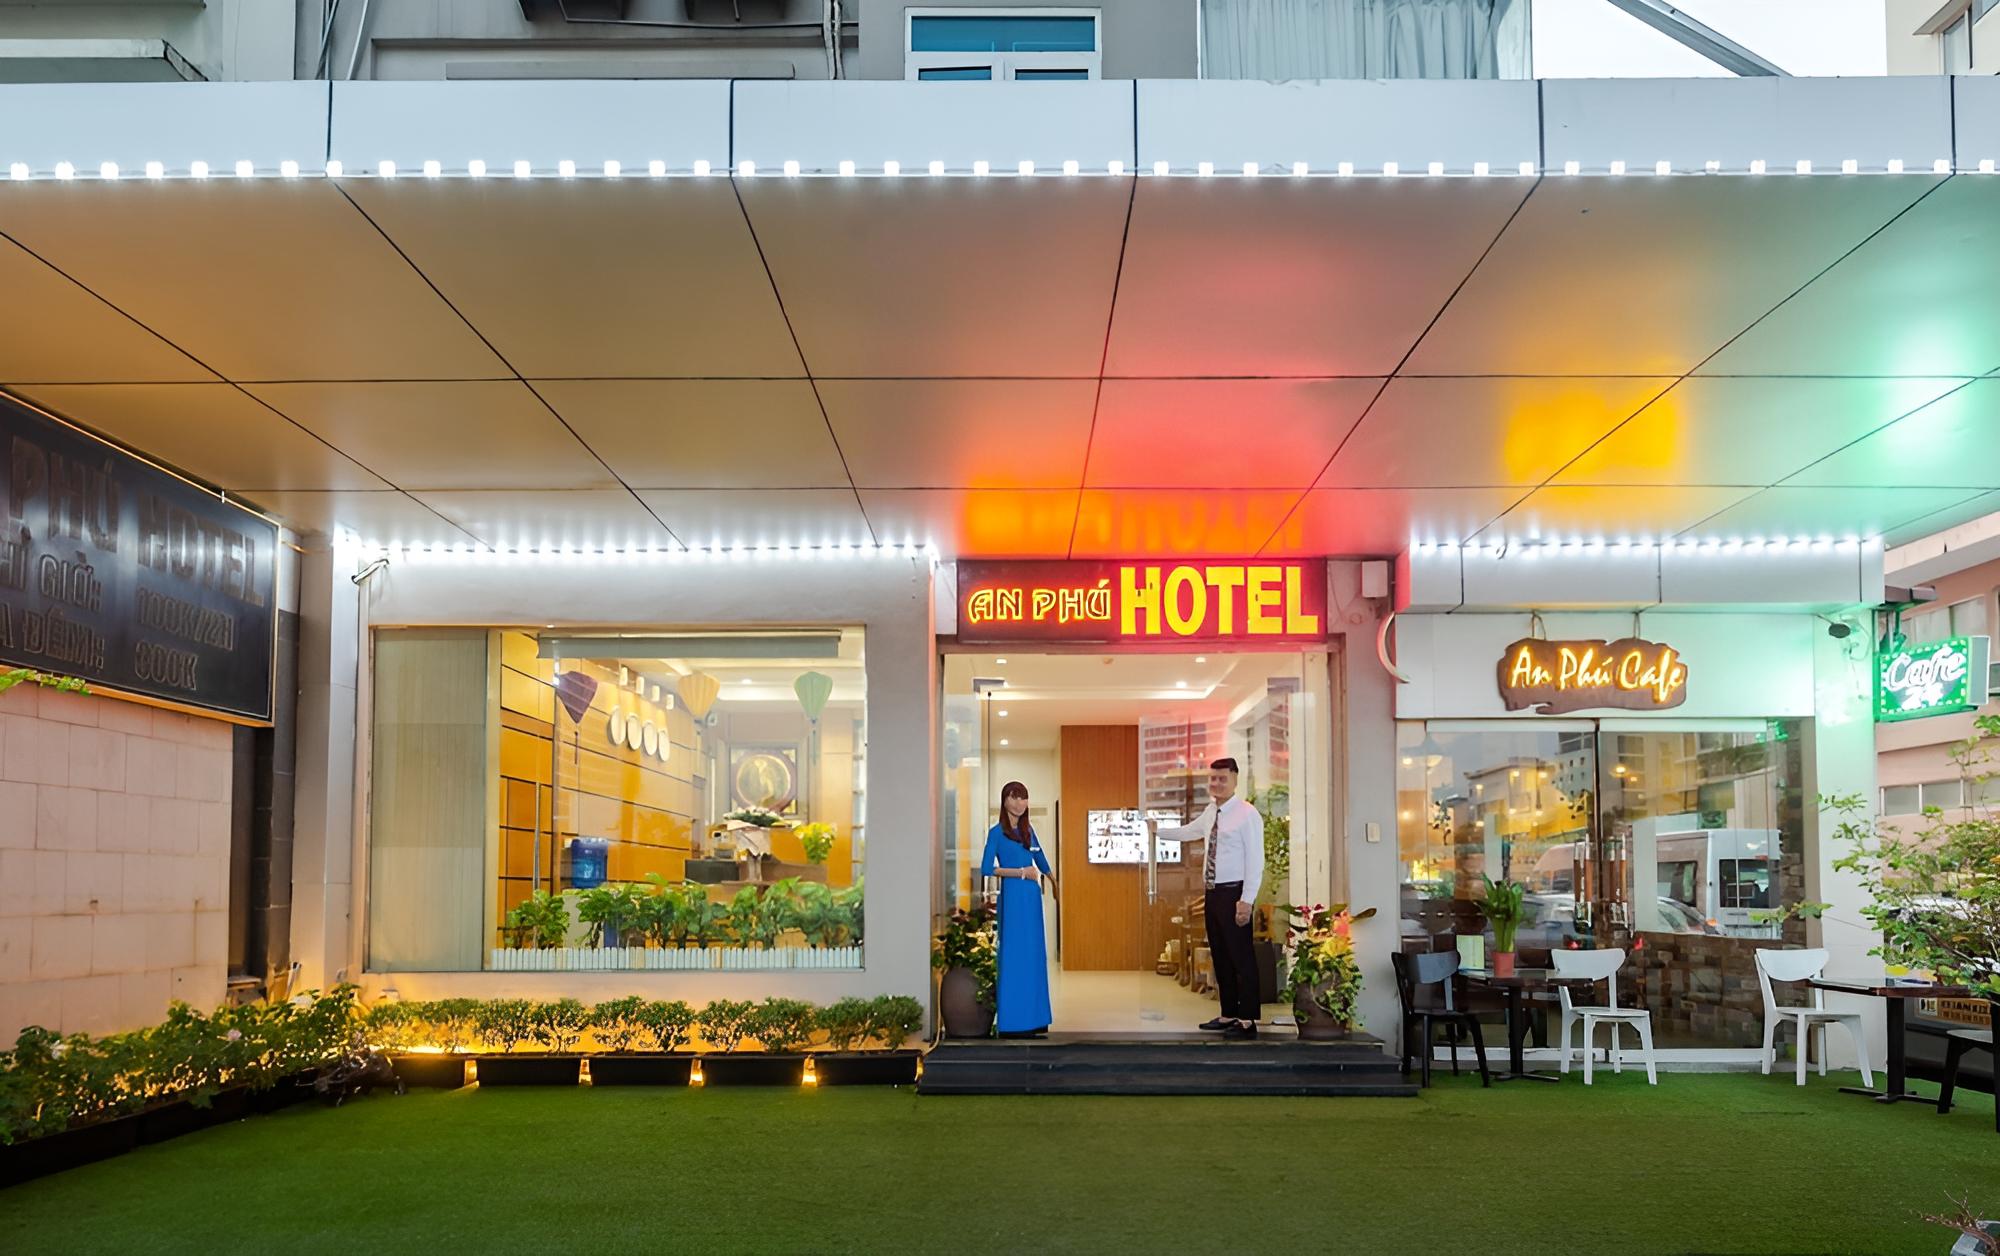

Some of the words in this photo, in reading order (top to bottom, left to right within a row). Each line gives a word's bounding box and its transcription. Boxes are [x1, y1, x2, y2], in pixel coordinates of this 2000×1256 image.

[137, 493, 264, 608] HOTEL
[967, 588, 1023, 623] AN
[1031, 579, 1111, 623] PHÚ
[1120, 566, 1319, 636] HOTEL
[1511, 646, 1552, 687] An
[1557, 647, 1614, 690] Phú
[1619, 648, 1684, 703] Cafe
